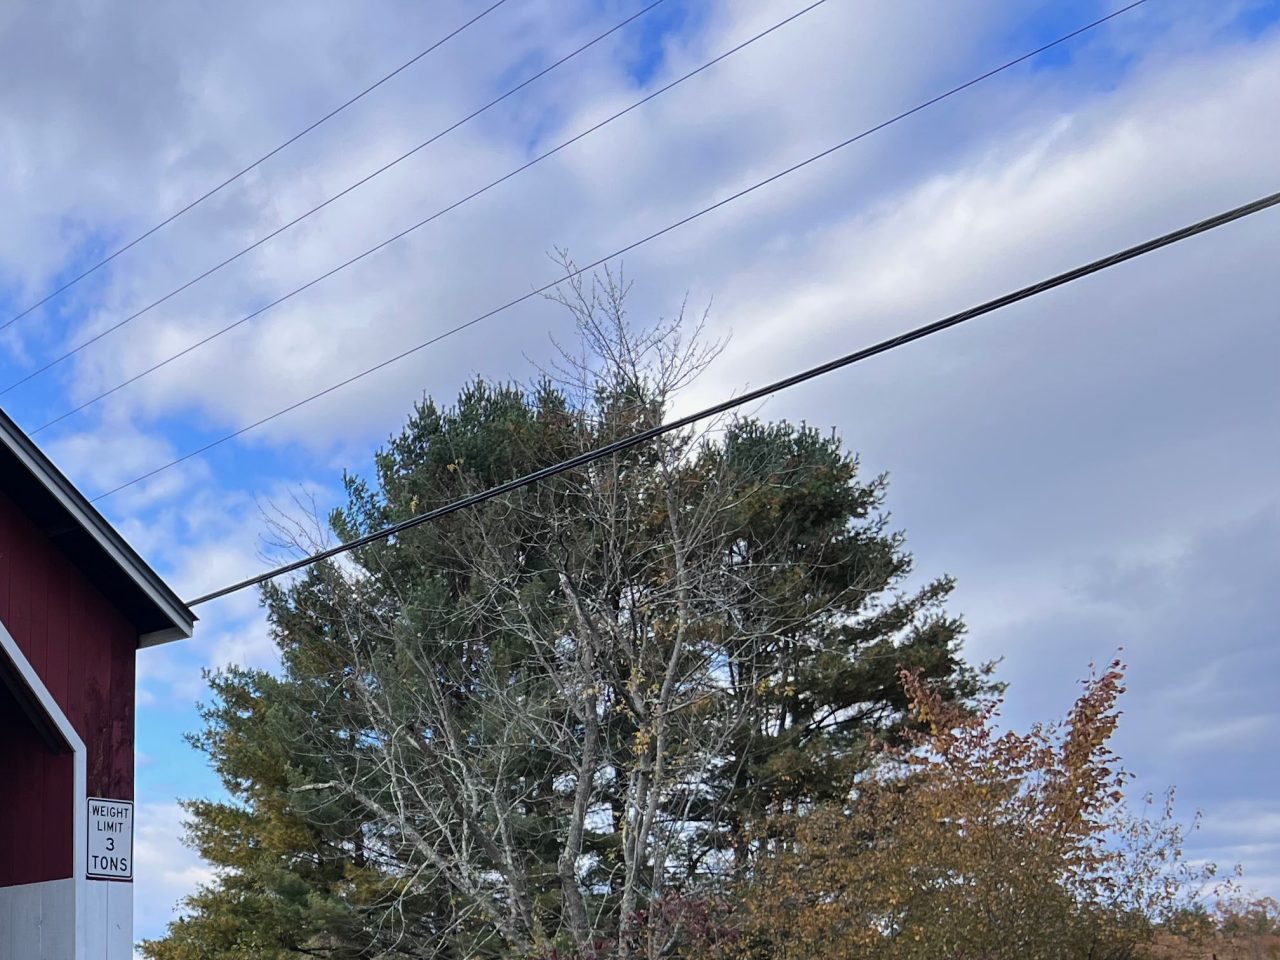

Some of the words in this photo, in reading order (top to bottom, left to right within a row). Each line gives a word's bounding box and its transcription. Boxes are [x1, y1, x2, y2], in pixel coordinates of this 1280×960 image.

[92, 805, 129, 819] WEIGHT
[97, 821, 124, 833] LIMIT
[105, 837, 115, 852] 3
[91, 855, 128, 872] TONS
